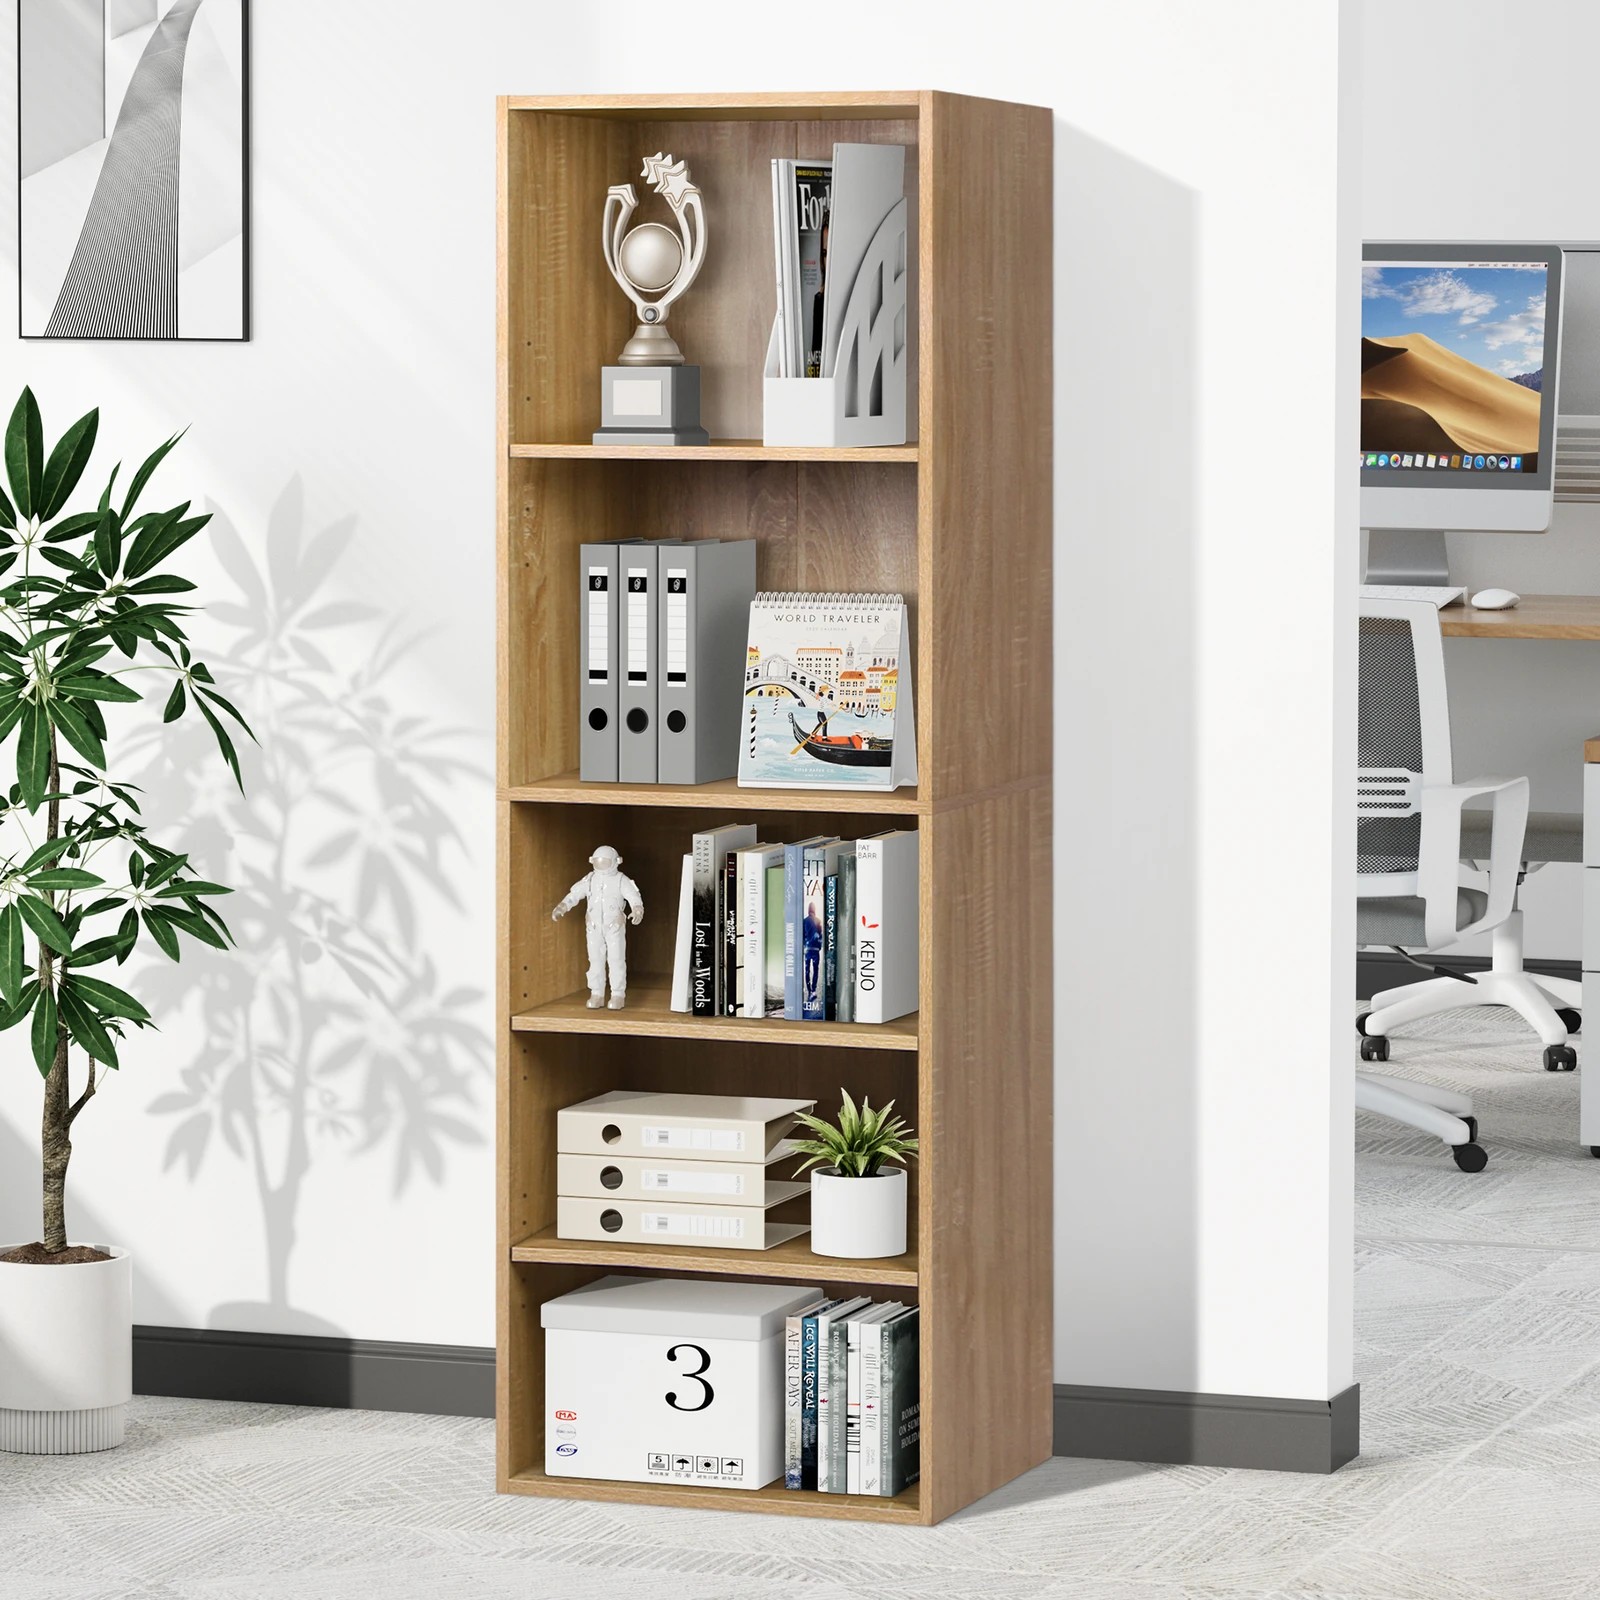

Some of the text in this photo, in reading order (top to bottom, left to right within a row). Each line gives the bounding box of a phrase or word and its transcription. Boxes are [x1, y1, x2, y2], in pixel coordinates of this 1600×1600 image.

[774, 614, 880, 623] WORLD TRAVELER
[695, 922, 711, 948] Lost
[860, 940, 876, 992] KENJO
[695, 967, 711, 1008] Woods
[665, 1343, 715, 1412] 3
[787, 1329, 800, 1408] AFTER DAYS
[789, 1418, 797, 1440] SCOTT
